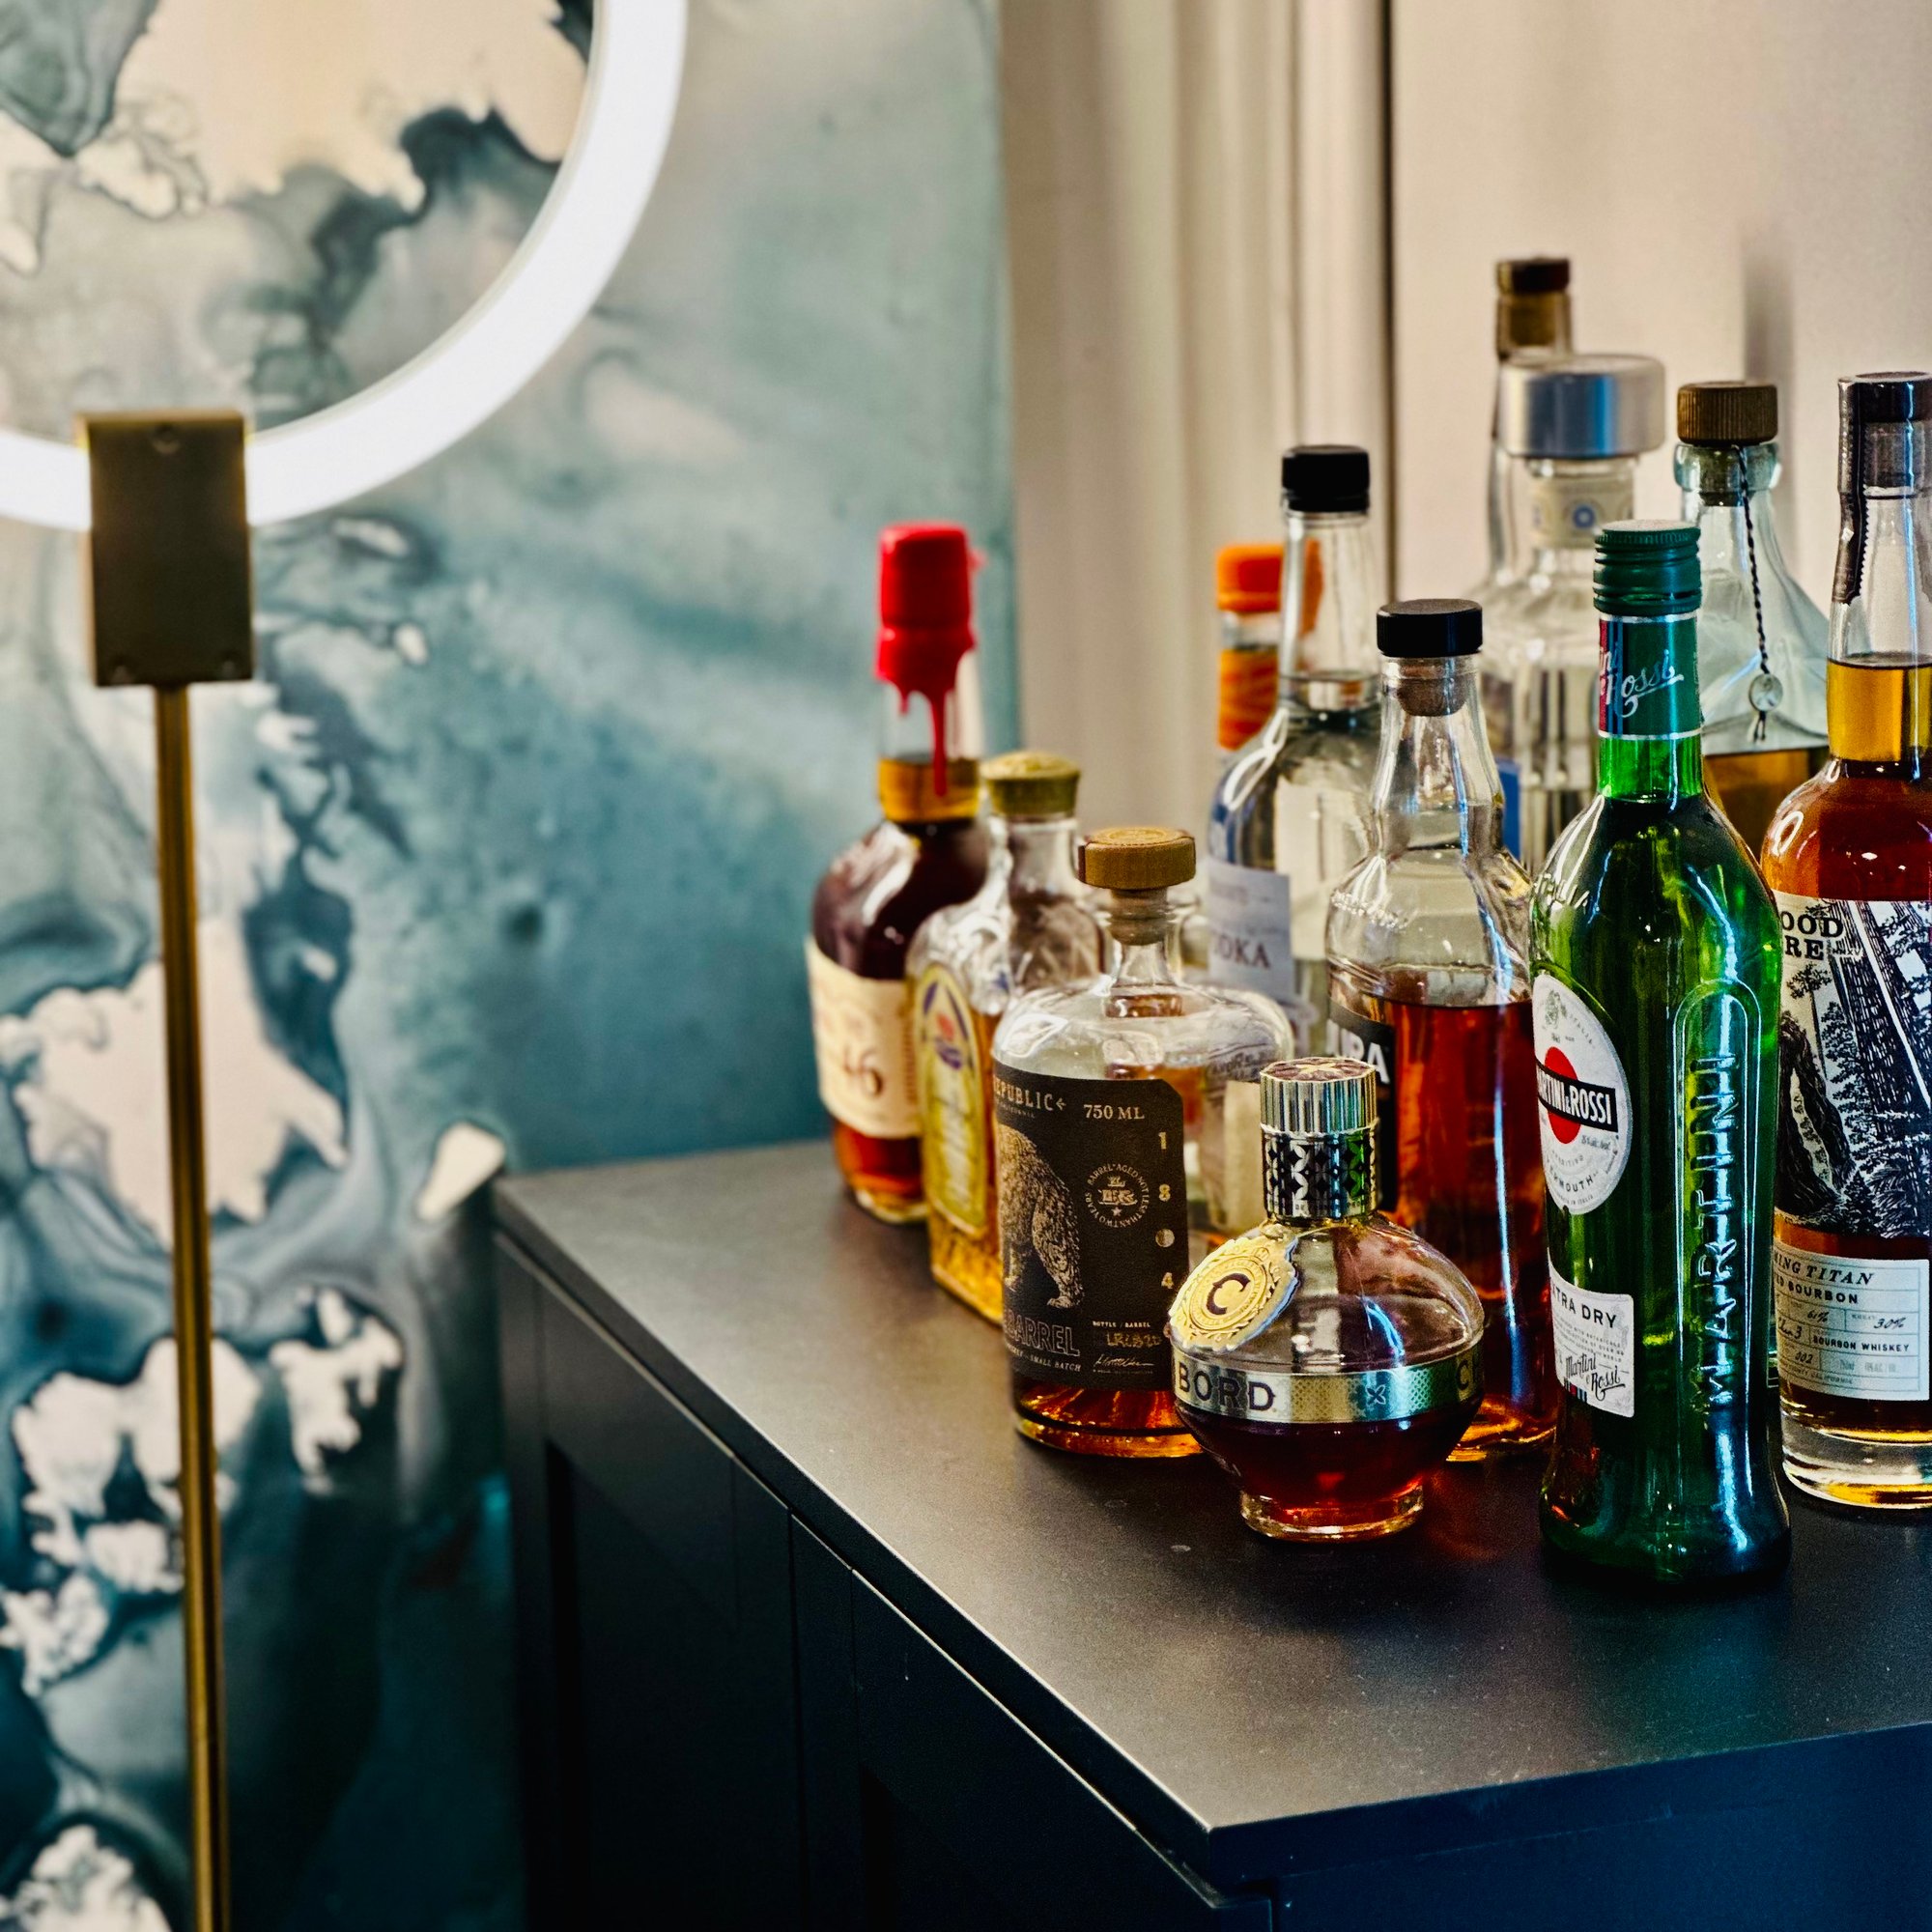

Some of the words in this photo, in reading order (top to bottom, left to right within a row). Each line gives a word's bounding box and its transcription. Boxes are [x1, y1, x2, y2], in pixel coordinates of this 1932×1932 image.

[1083, 1104, 1114, 1120] 750
[1118, 1106, 1146, 1121] ML
[1806, 1264, 1873, 1286] TITAN
[1207, 1271, 1252, 1316] C
[1788, 1280, 1860, 1305] BOURBON
[1581, 1304, 1617, 1329] DRY
[1873, 1317, 1907, 1331] 30%
[1813, 1333, 1857, 1350] BOURBON
[1861, 1342, 1910, 1352] WHISKEY
[1177, 1362, 1276, 1411] BORD
